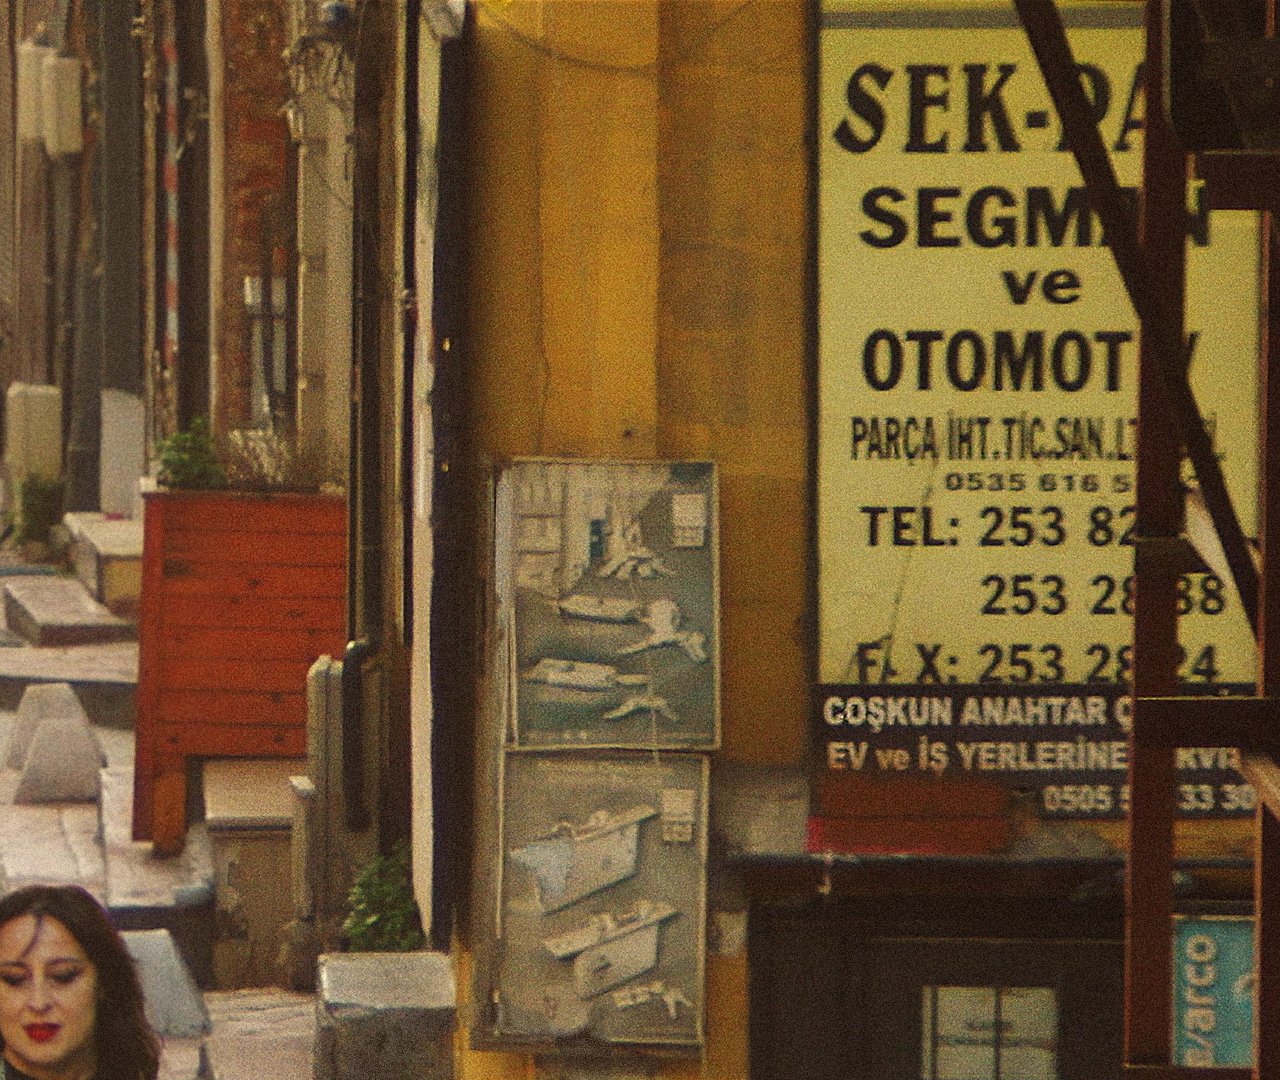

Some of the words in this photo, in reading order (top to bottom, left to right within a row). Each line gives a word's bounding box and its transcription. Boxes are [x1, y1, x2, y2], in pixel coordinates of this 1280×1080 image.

[833, 61, 1147, 154] SEK-PA
[859, 185, 1210, 249] SEGMN
[1003, 270, 1082, 305] ve
[862, 329, 1200, 393] OTOMOT
[851, 415, 938, 464] PARÇA
[861, 506, 960, 547] TEL:
[979, 507, 1066, 548] 253
[980, 574, 1066, 616] 253
[978, 643, 1064, 684] 253
[823, 696, 953, 733] COŞKUN
[960, 696, 1106, 725] ANAHTAR
[828, 741, 869, 770] EV
[874, 749, 910, 770] ve
[955, 735, 1130, 770] YERLERİNE
